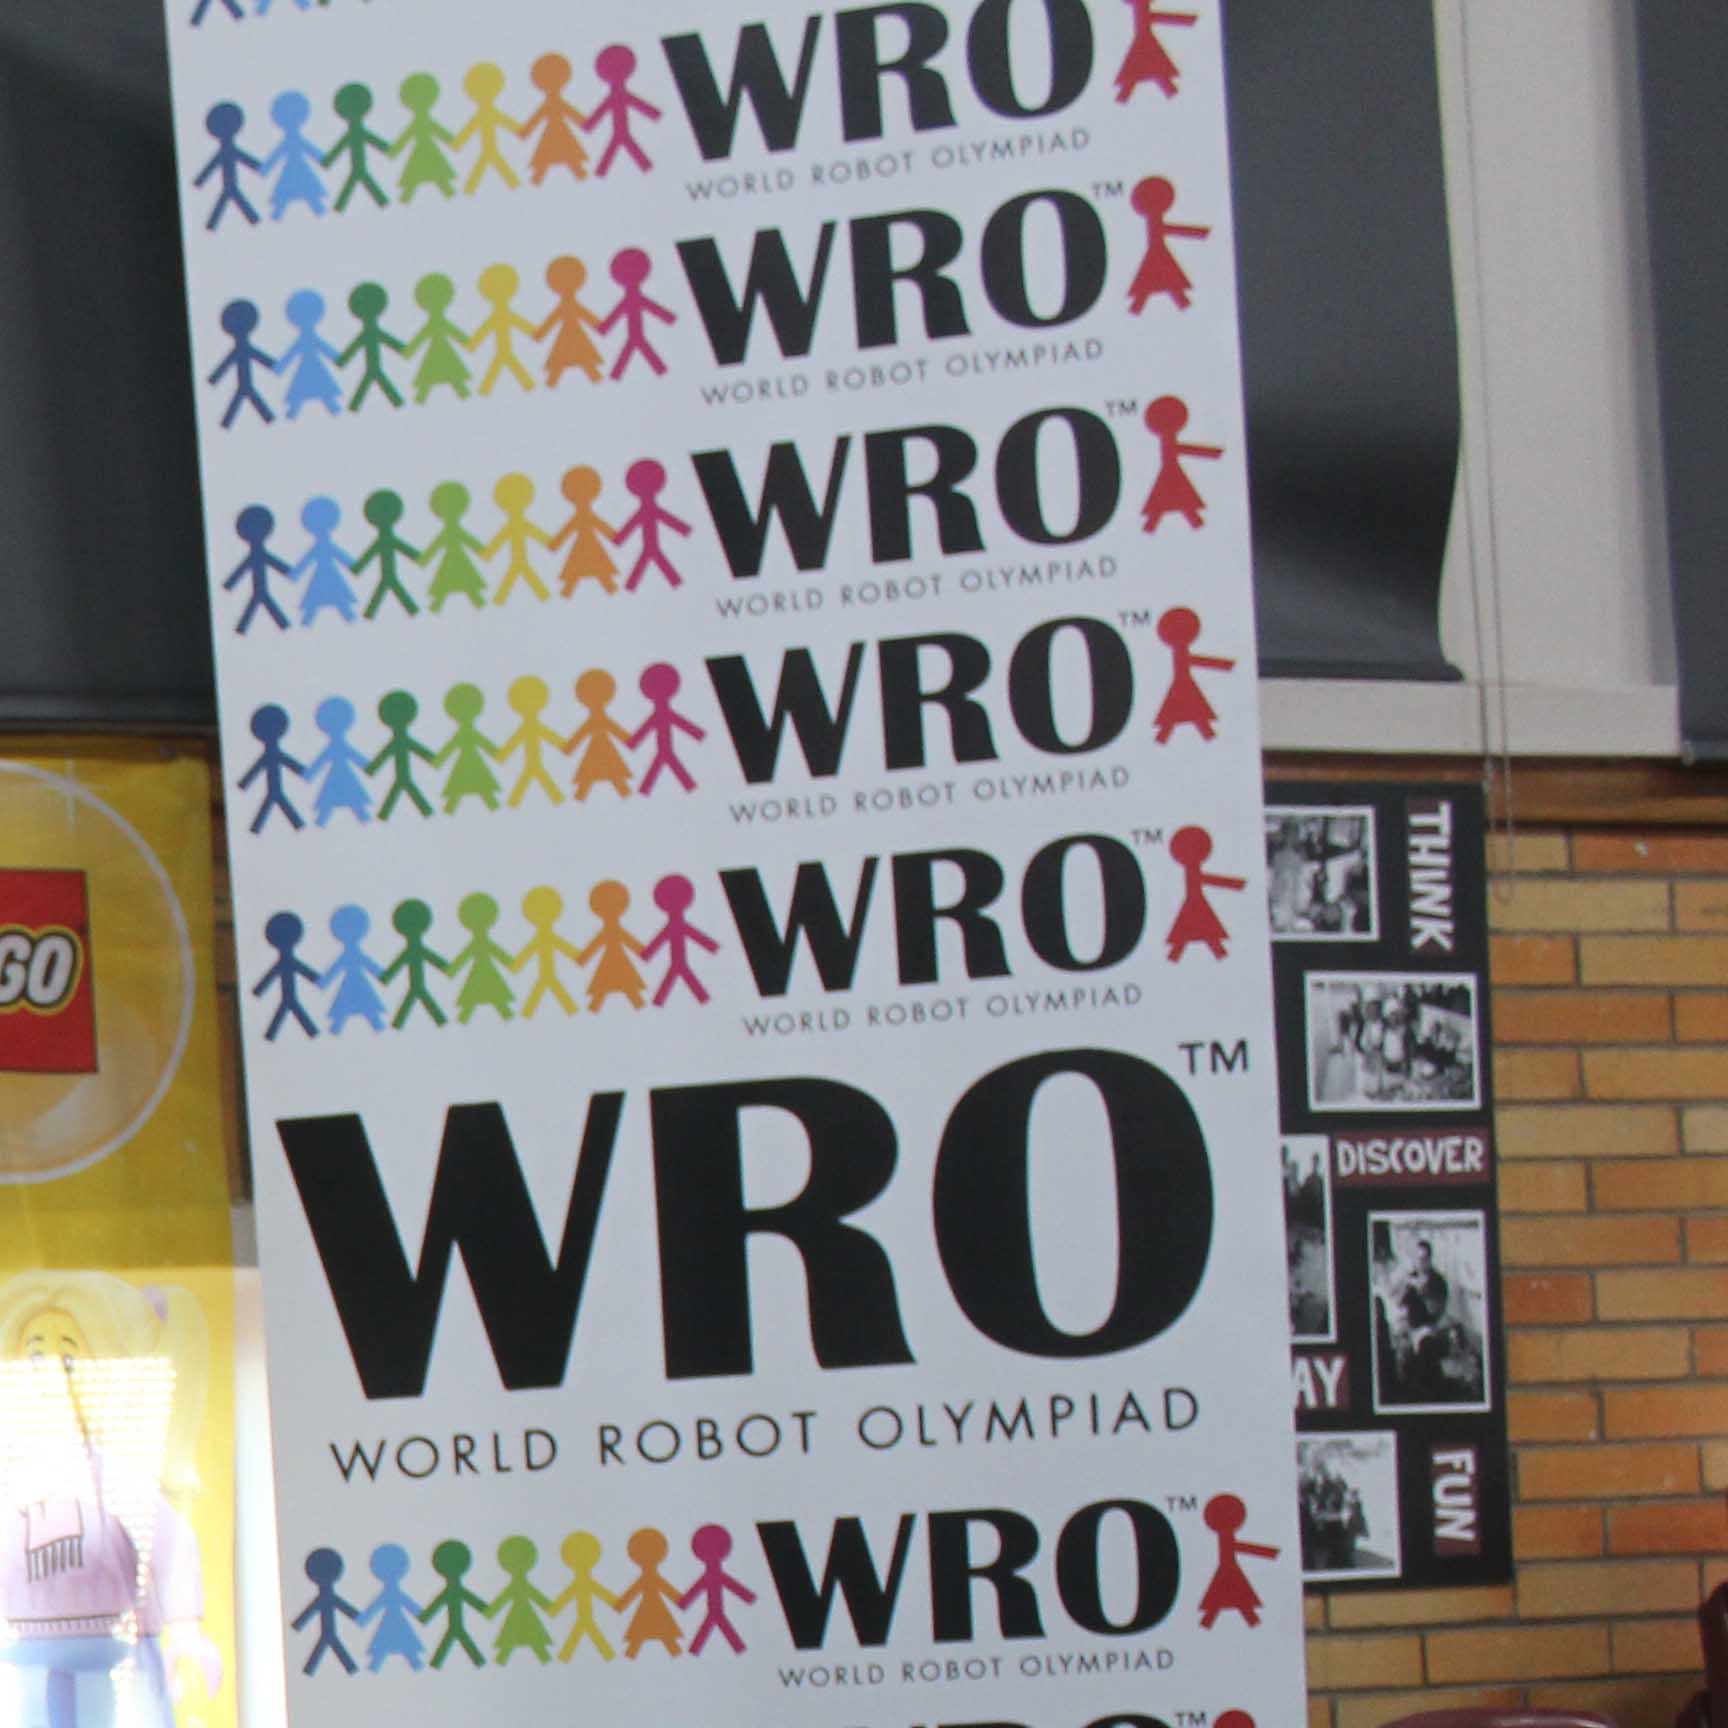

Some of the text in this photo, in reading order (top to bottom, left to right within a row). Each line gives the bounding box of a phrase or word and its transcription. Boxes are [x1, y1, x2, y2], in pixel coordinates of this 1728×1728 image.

[660, 0, 1094, 162] WRO
[685, 127, 1091, 201] WORLD ROBOT OLYMPIAD
[675, 188, 1108, 367] WRO
[700, 337, 1104, 406] WORLD ROBOT OLYMPIAD
[690, 407, 1122, 579] WRO
[715, 555, 1118, 618] WORLD ROBOT OLYMPIAD
[704, 616, 1135, 784] WRO
[728, 765, 1131, 825] WORLD ROBOT OLYMPIAD
[717, 832, 1148, 998] WRO
[1408, 801, 1454, 951] THINK
[742, 982, 1143, 1036] WORLD ROBOT OLYMPIAD
[1336, 1135, 1484, 1177] DISCOVER
[275, 1047, 1215, 1401] WRO
[330, 1387, 1200, 1484] WORLD ROBOT OLYMPIAD
[1432, 1450, 1477, 1541] FUN
[755, 1497, 1181, 1650] WRO
[778, 1649, 1175, 1688] WORLD ROBOT OLYMPIAD
